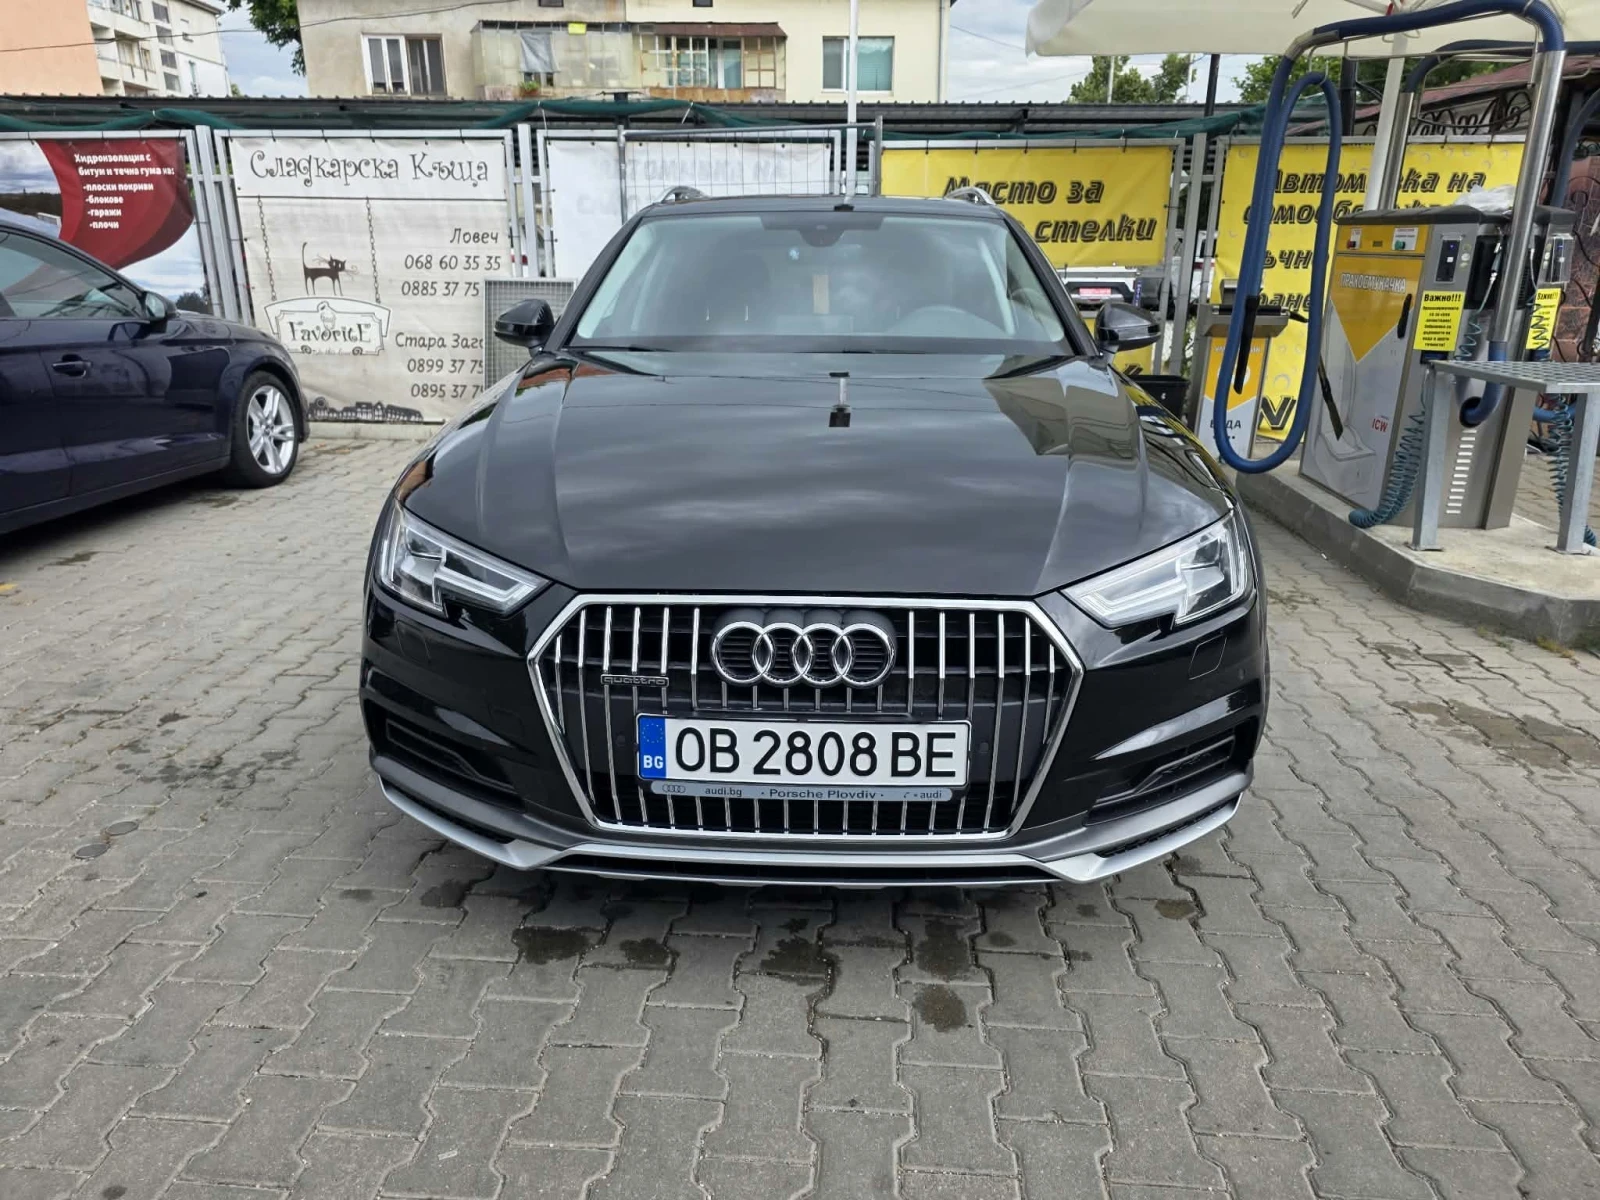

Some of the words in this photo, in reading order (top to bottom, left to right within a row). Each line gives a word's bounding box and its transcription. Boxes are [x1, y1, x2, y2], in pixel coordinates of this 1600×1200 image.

[140, 167, 161, 177] гума
[250, 149, 399, 187] Сладкарска
[410, 152, 489, 187] Къща
[1447, 172, 1487, 193] на
[1066, 180, 1105, 204] за
[450, 227, 499, 244] Ловеч
[1034, 214, 1158, 243] стелки
[404, 254, 433, 270] 068
[439, 254, 458, 270] 60
[463, 255, 480, 271] 35
[484, 255, 501, 271] 35
[401, 280, 438, 296] 0885
[442, 281, 459, 297] 37
[464, 281, 480, 297] 75
[1424, 293, 1461, 302] Важно!!!
[395, 331, 447, 351] Стара
[407, 358, 444, 373] 0899
[448, 359, 466, 374] 37
[411, 383, 446, 398] 0895
[450, 384, 467, 399] 37
[1372, 418, 1388, 432] ICW
[604, 676, 666, 685] quattro
[675, 727, 740, 773] OB
[753, 729, 878, 777] 2808
[891, 731, 956, 777] BE
[643, 755, 664, 769] BG
[705, 786, 742, 797] audi.bg
[769, 788, 823, 799] Porsche
[827, 789, 876, 799] Plovdiv
